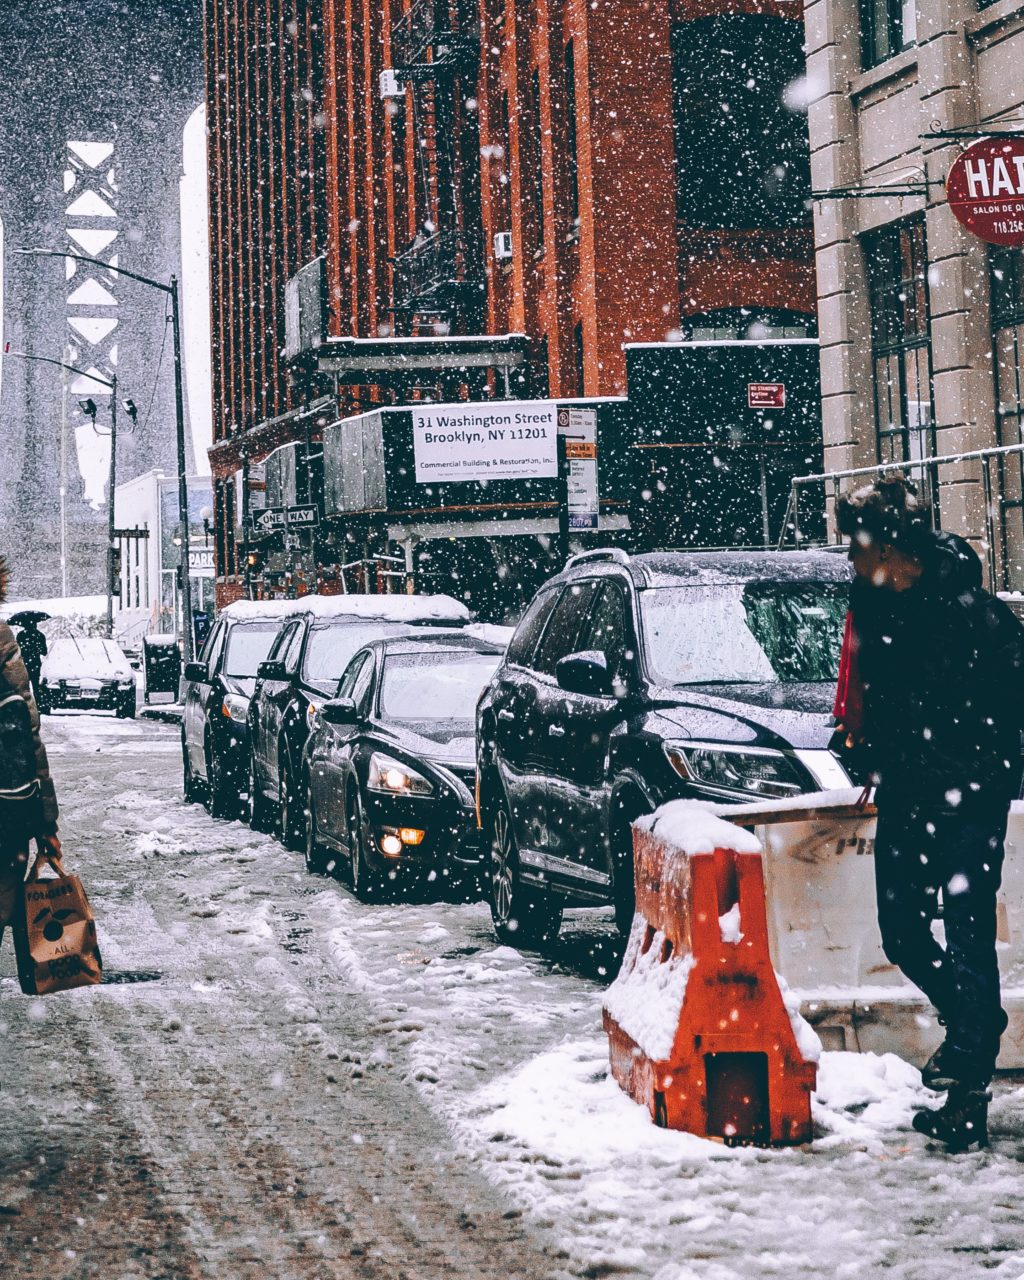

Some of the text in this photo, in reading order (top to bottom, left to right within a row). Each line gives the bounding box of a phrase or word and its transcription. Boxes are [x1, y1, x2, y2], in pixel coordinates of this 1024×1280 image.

[972, 205, 1001, 215] SALON
[1002, 204, 1014, 212] DE
[417, 413, 553, 428] 31 Washington Street
[424, 428, 548, 444] Brooklyn, NY 11201
[420, 460, 461, 469] Commercial
[462, 460, 491, 468] Building
[499, 457, 542, 466] Restoraon,
[263, 511, 310, 524] ONE WAY
[27, 883, 73, 902] FORGERS
[54, 945, 69, 955] ALL
